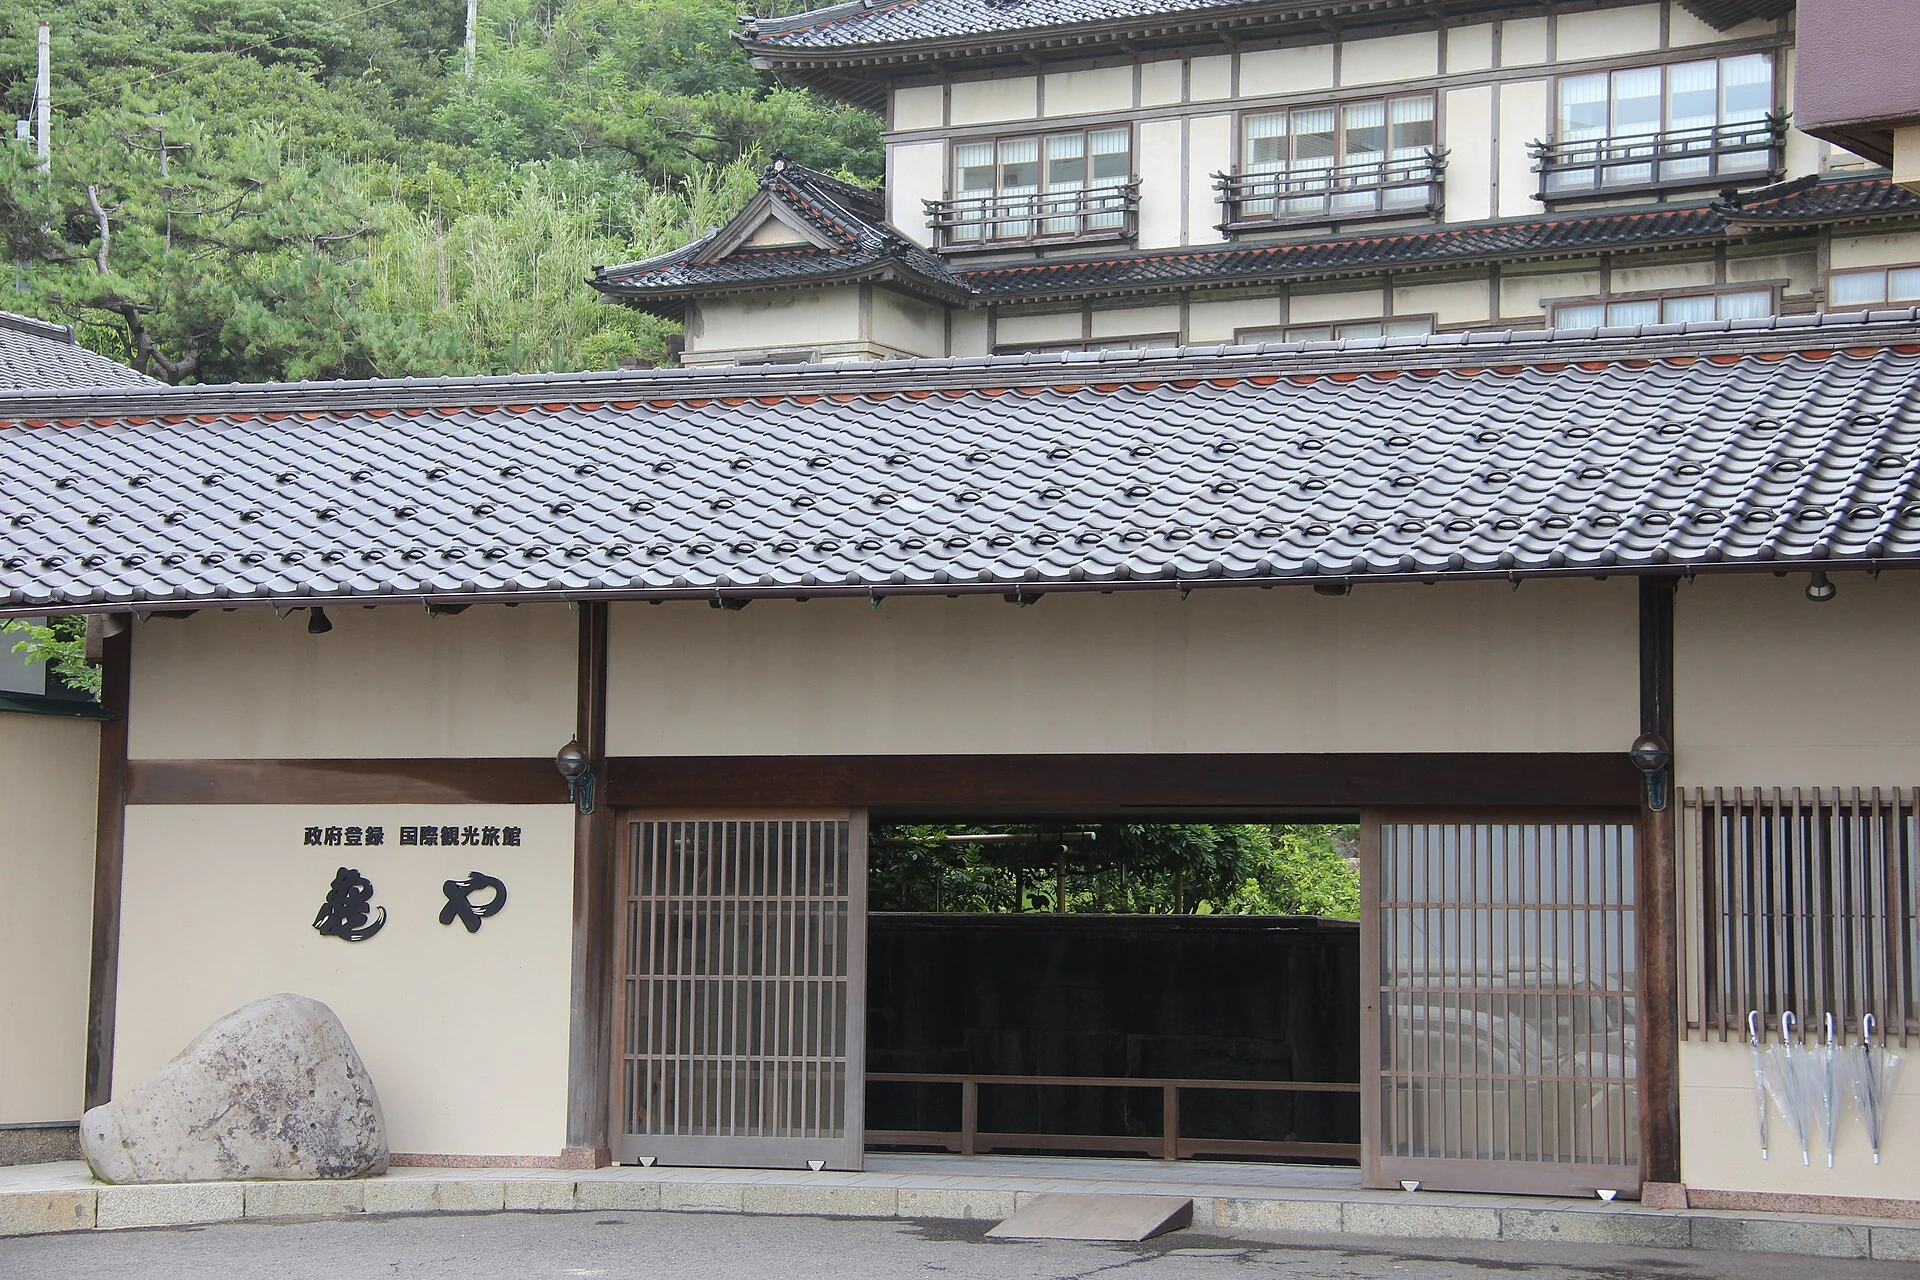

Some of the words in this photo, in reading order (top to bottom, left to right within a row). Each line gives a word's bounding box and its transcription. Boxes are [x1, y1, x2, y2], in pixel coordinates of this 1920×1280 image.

[303, 825, 385, 847] 政府登録
[399, 825, 522, 847] 国際観光旅館
